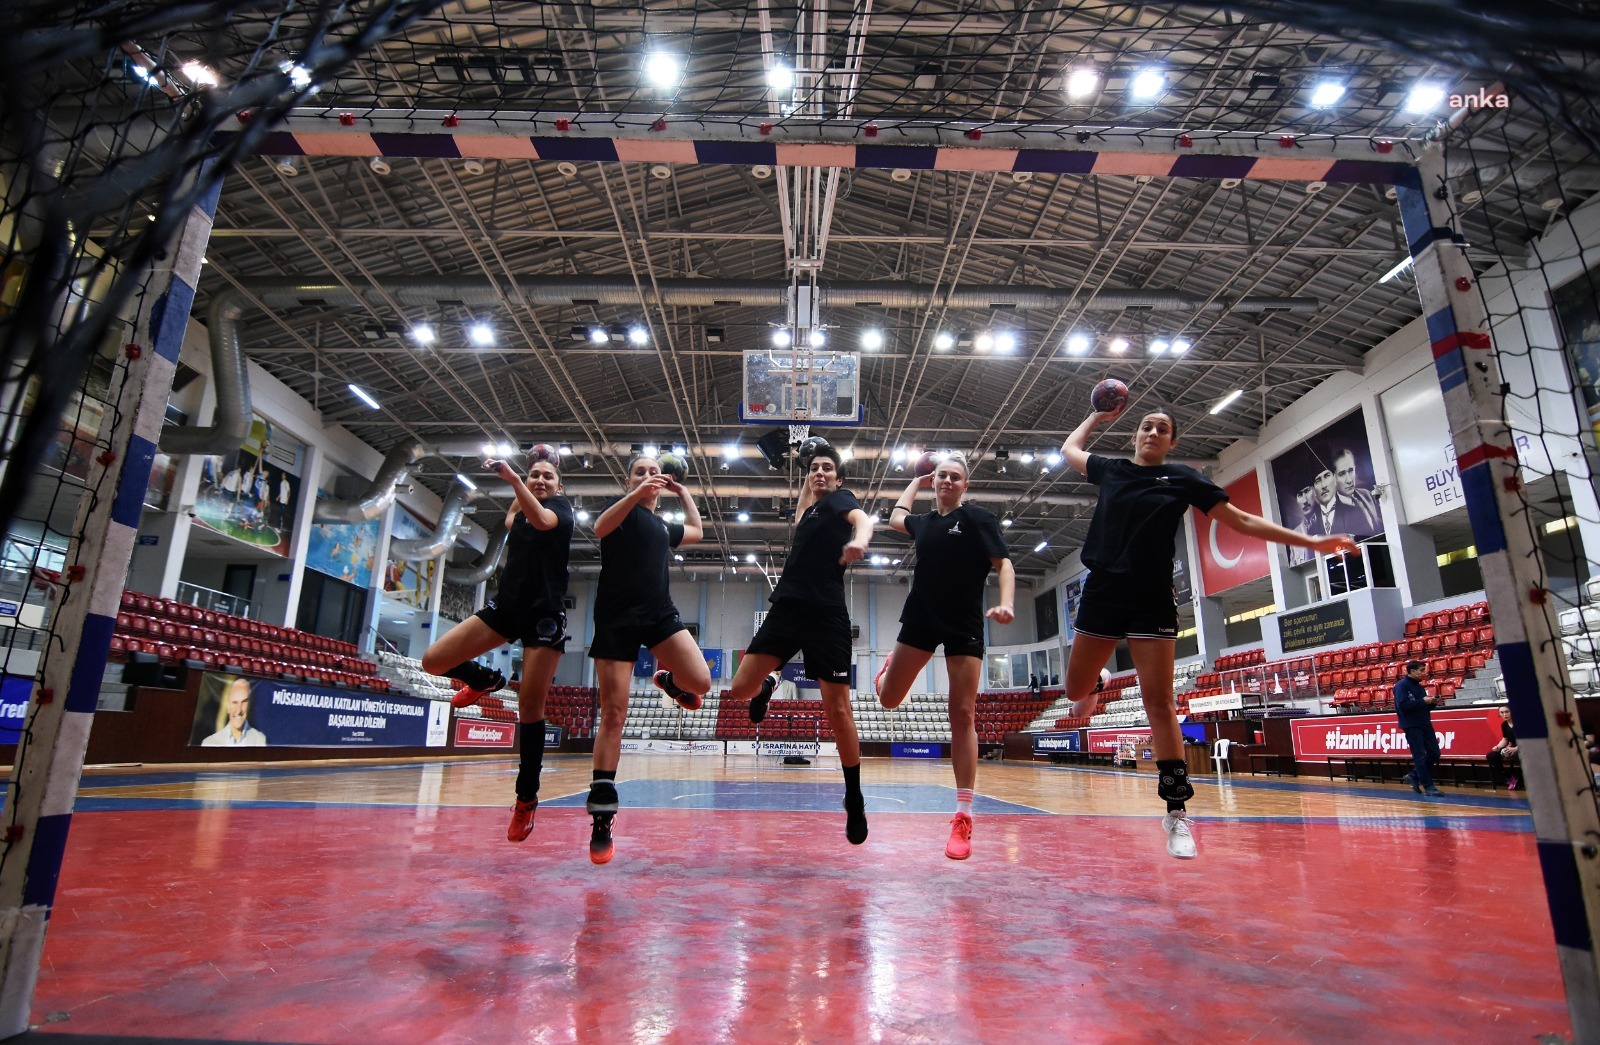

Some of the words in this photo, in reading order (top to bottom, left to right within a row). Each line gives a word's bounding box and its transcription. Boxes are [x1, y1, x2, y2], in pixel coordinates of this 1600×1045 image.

[272, 689, 334, 709] MÜSABAKALARA
[333, 697, 360, 711] KATILAN
[360, 698, 386, 713] YÖNETİCİ
[386, 703, 394, 714] VE
[393, 704, 425, 717] SPORCULARA
[328, 713, 364, 728] BAŞARILAR
[364, 715, 387, 728] DİLERİM
